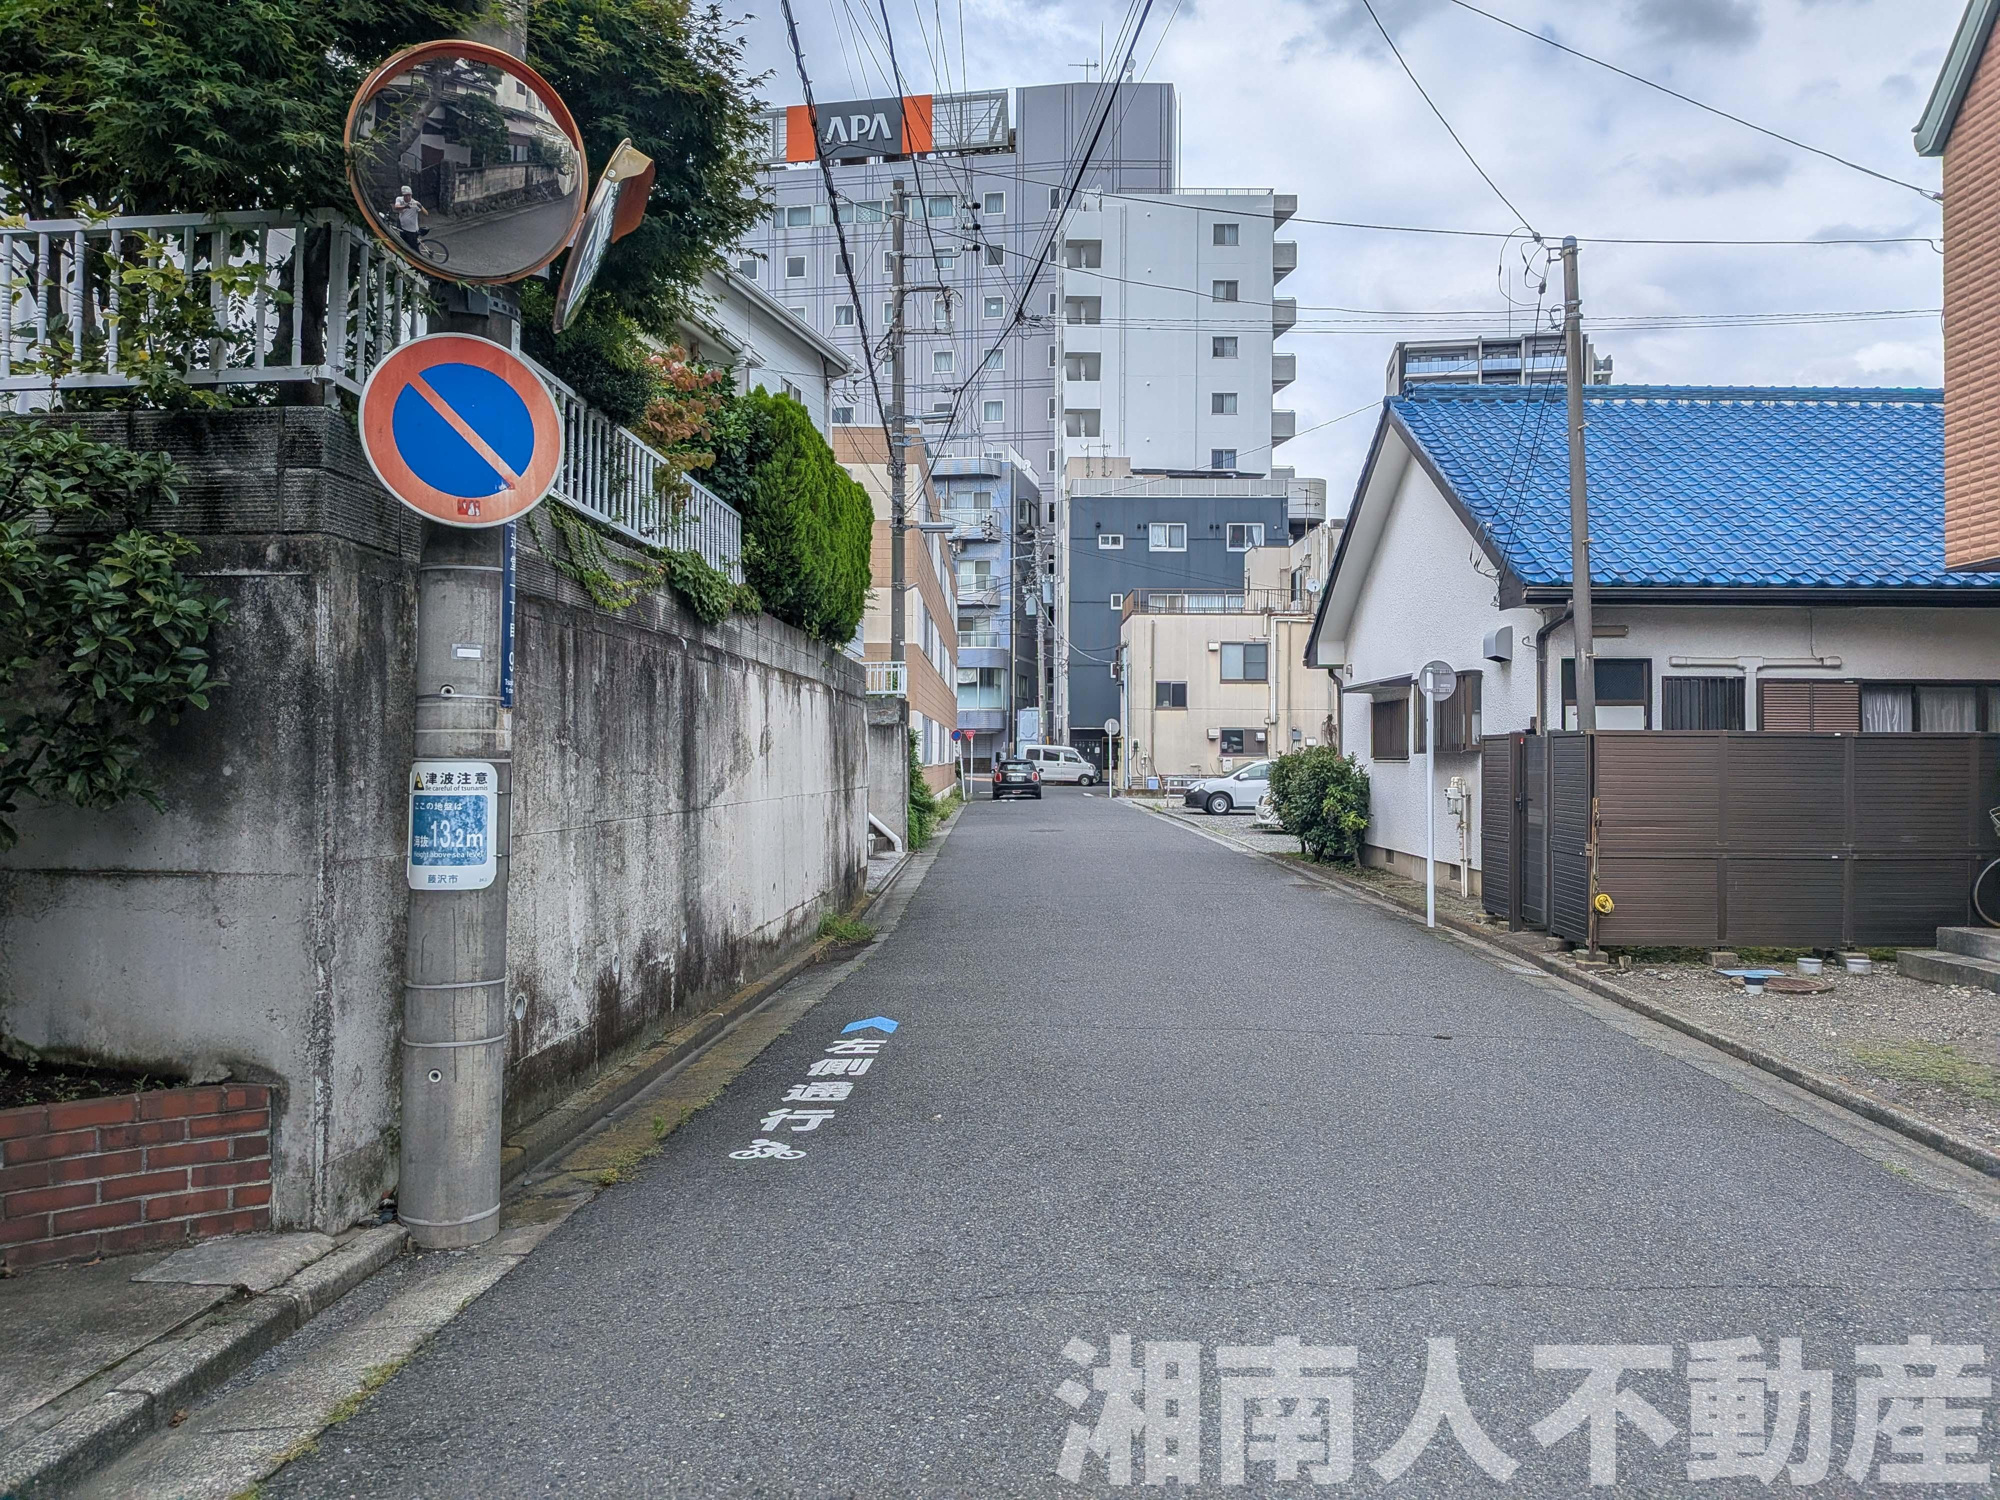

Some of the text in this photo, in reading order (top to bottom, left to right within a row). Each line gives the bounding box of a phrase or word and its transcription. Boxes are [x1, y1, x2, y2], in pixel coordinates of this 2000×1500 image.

[824, 112, 893, 145] APA
[425, 772, 488, 785] 津波注意
[414, 802, 463, 811] ここの地盤は
[429, 850, 452, 858] above
[427, 874, 458, 884] 藤沢市
[760, 1038, 887, 1131] 左側通行
